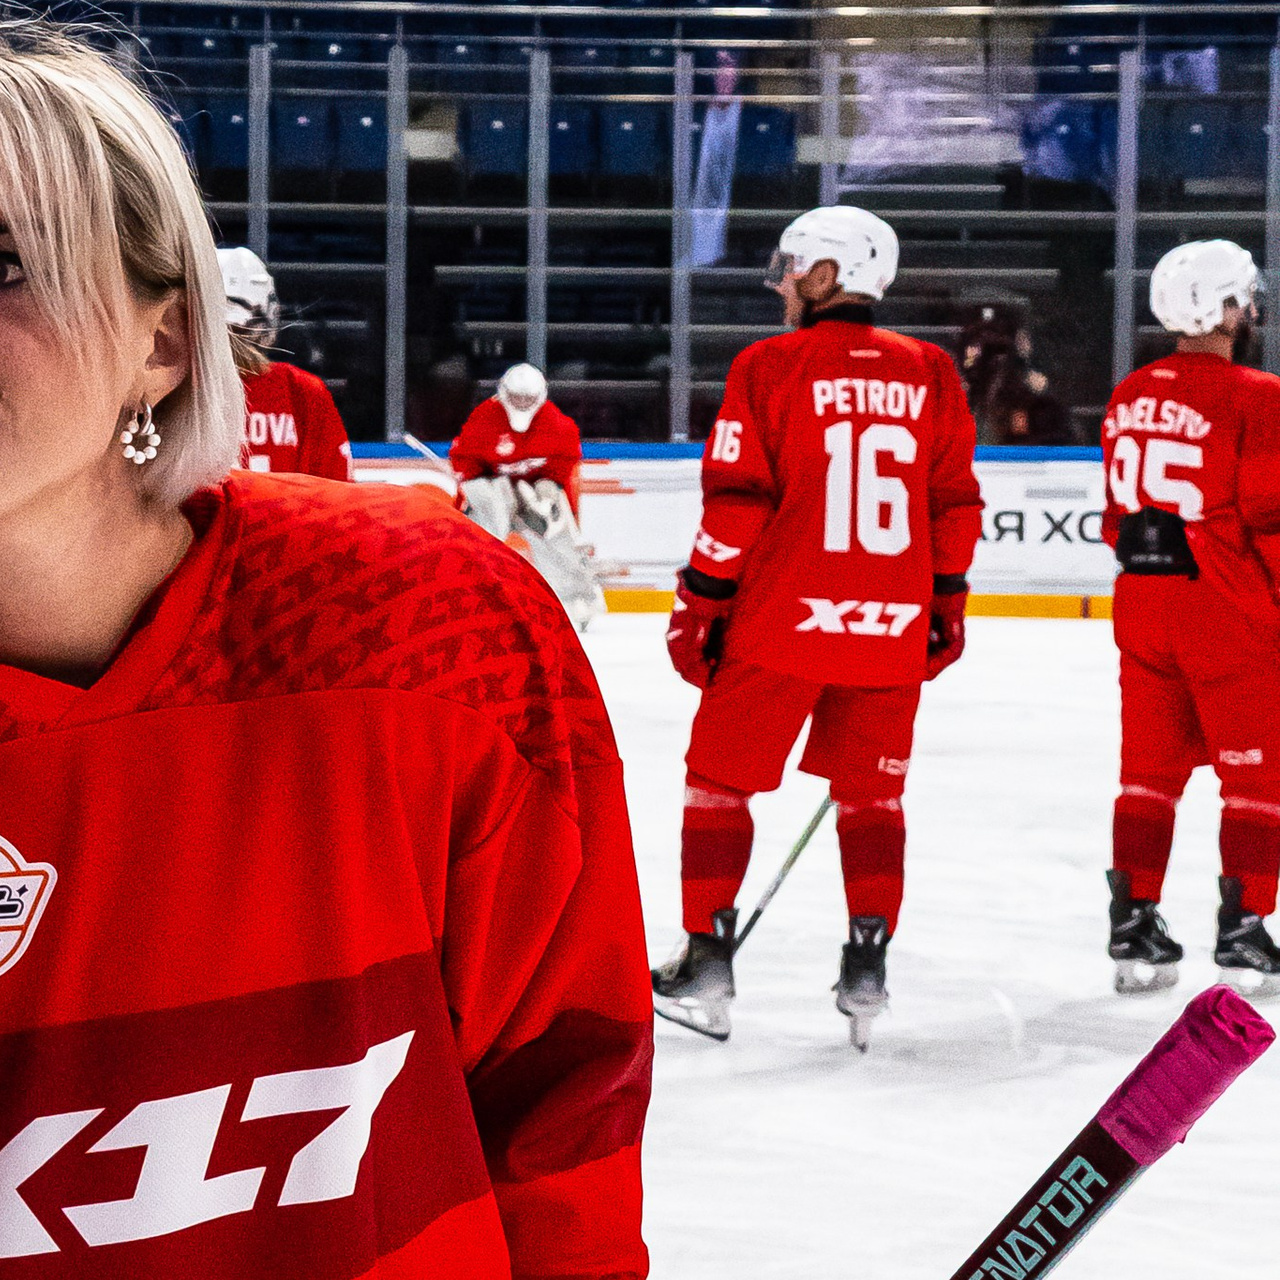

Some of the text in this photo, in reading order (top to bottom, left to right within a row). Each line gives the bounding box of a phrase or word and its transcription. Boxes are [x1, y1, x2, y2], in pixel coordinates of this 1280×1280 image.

[813, 377, 927, 420] PETROV
[246, 411, 299, 446] OVA
[711, 419, 743, 463] 16
[823, 420, 918, 556] 16
[982, 511, 1024, 542] Я
[795, 597, 922, 638] X17
